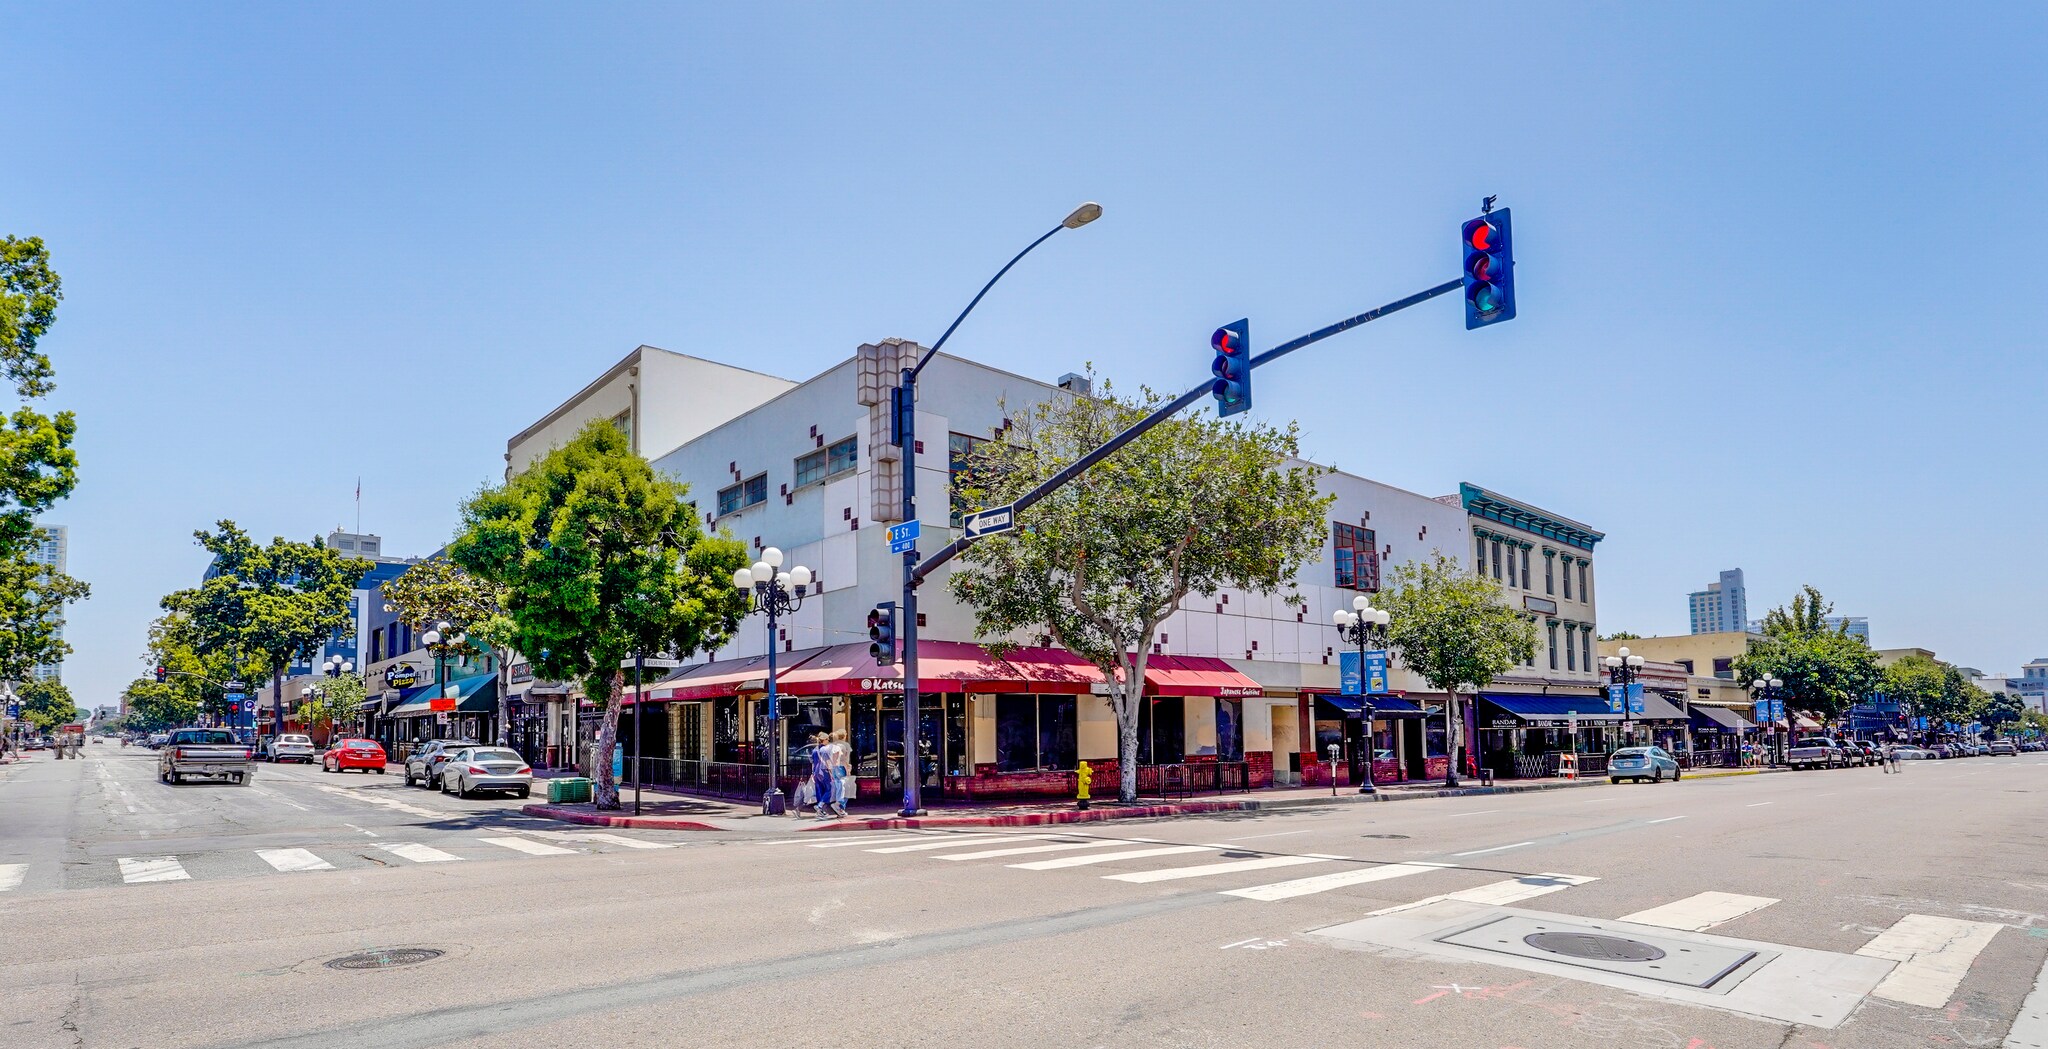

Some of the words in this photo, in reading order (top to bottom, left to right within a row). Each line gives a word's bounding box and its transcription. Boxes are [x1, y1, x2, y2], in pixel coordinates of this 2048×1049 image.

[979, 517, 991, 529] ONE
[993, 514, 1006, 525] WAY
[894, 529, 900, 540] E
[901, 541, 911, 550] 400
[647, 659, 671, 667] FOURTH
[393, 678, 415, 687] Pizza
[1220, 687, 1241, 697] Japanese
[1242, 687, 1260, 696] Cuisine
